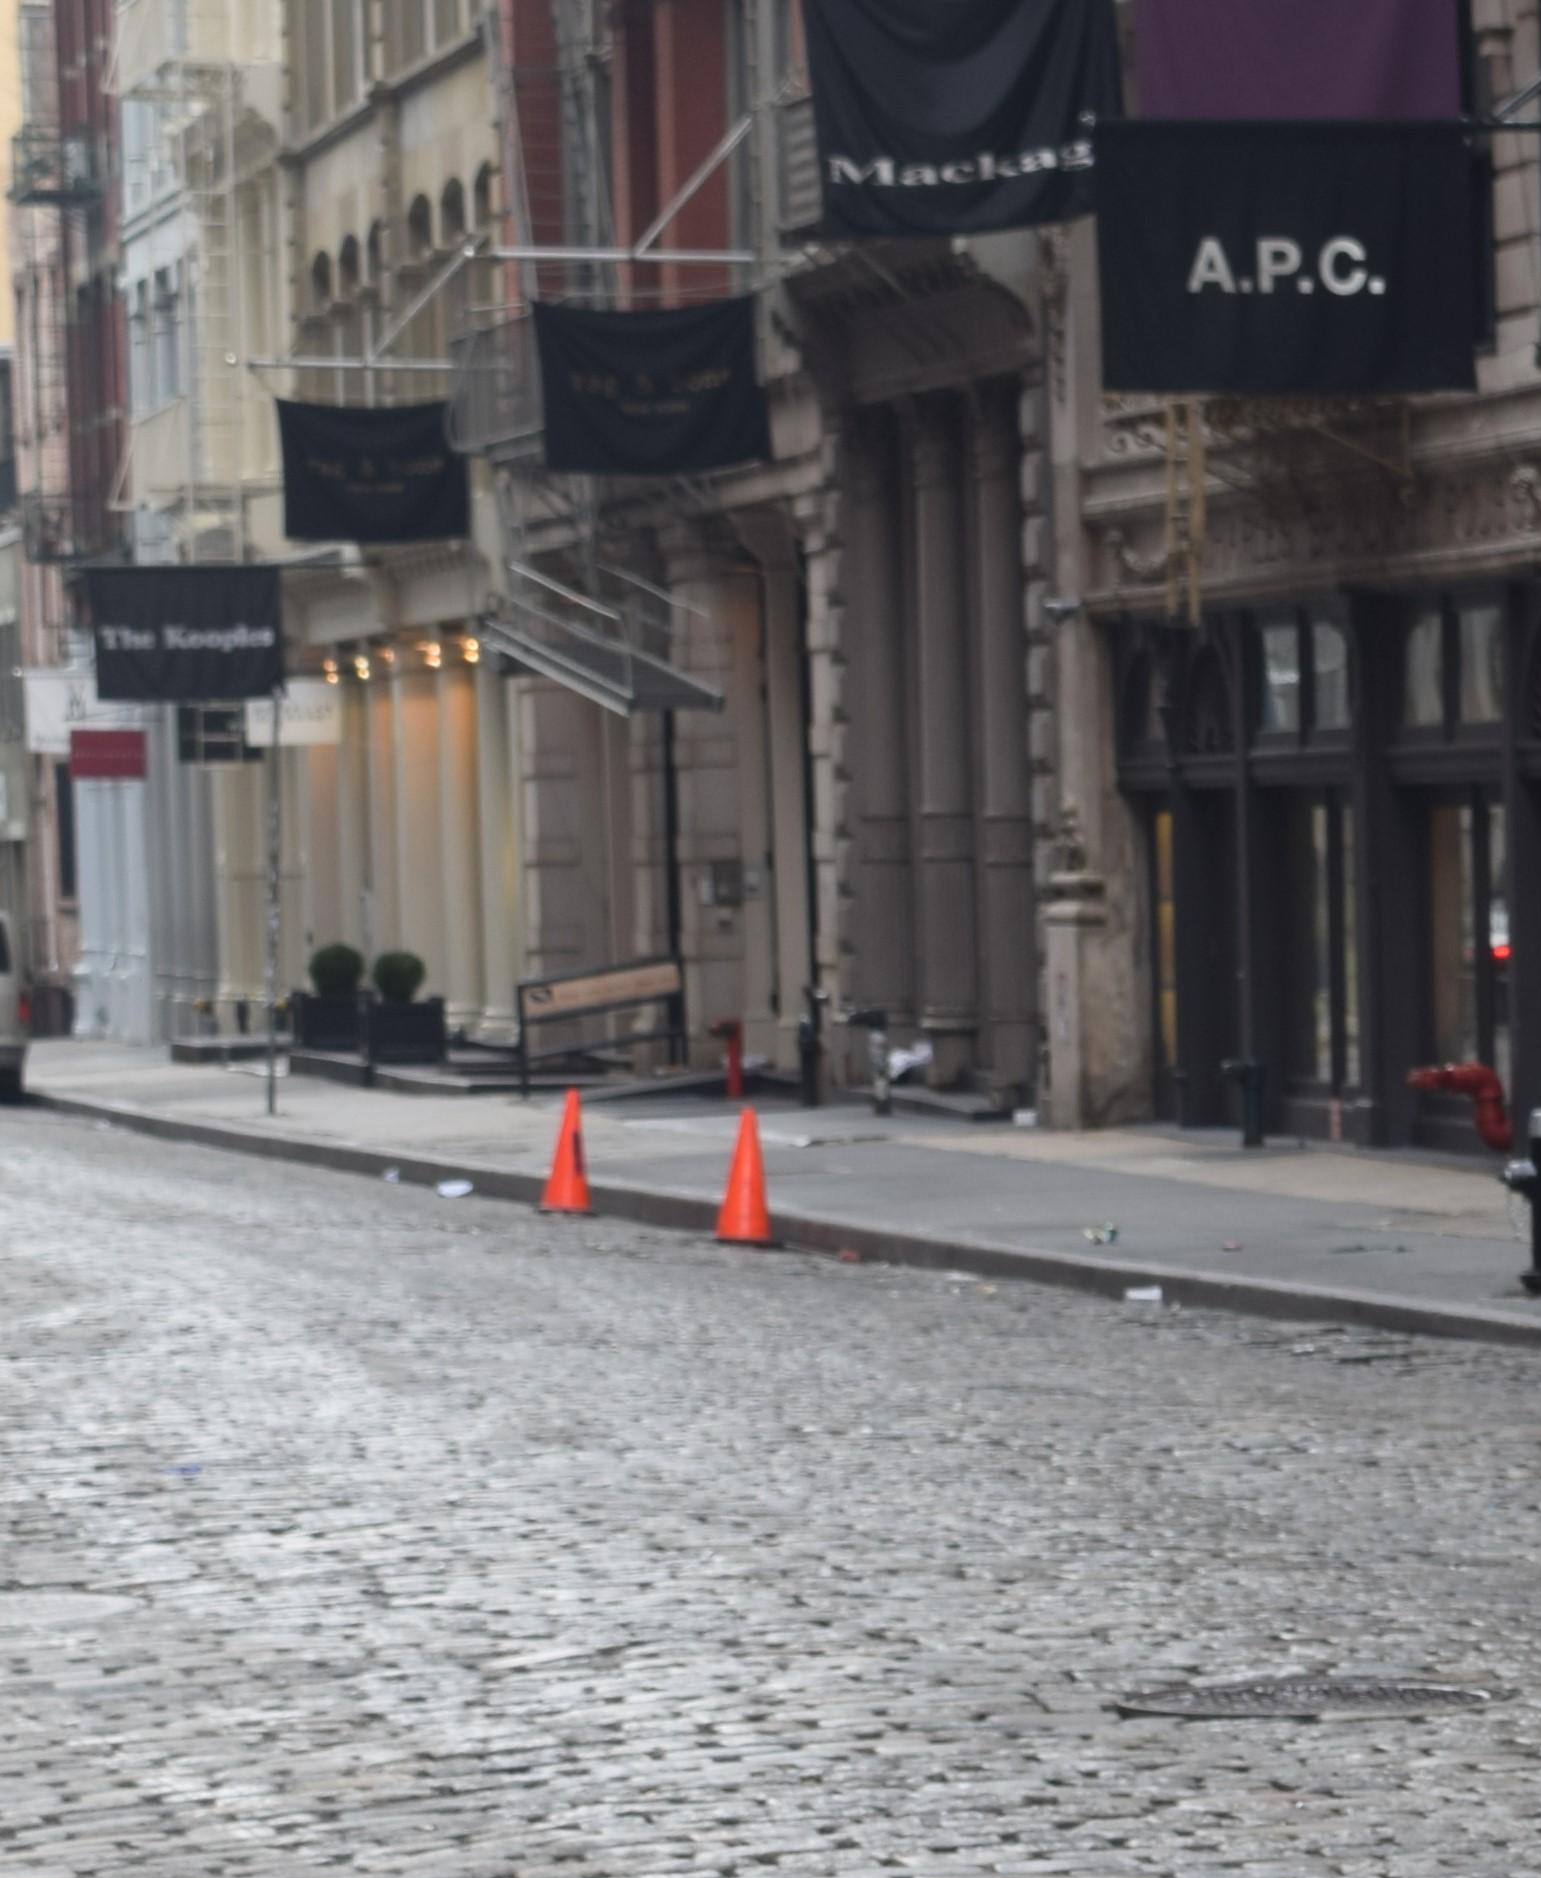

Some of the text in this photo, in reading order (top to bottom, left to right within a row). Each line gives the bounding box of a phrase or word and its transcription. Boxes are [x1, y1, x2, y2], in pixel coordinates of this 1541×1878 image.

[828, 138, 1096, 188] Mackag
[1186, 234, 1387, 297] A.P.C.
[101, 622, 276, 654] The Kooples
